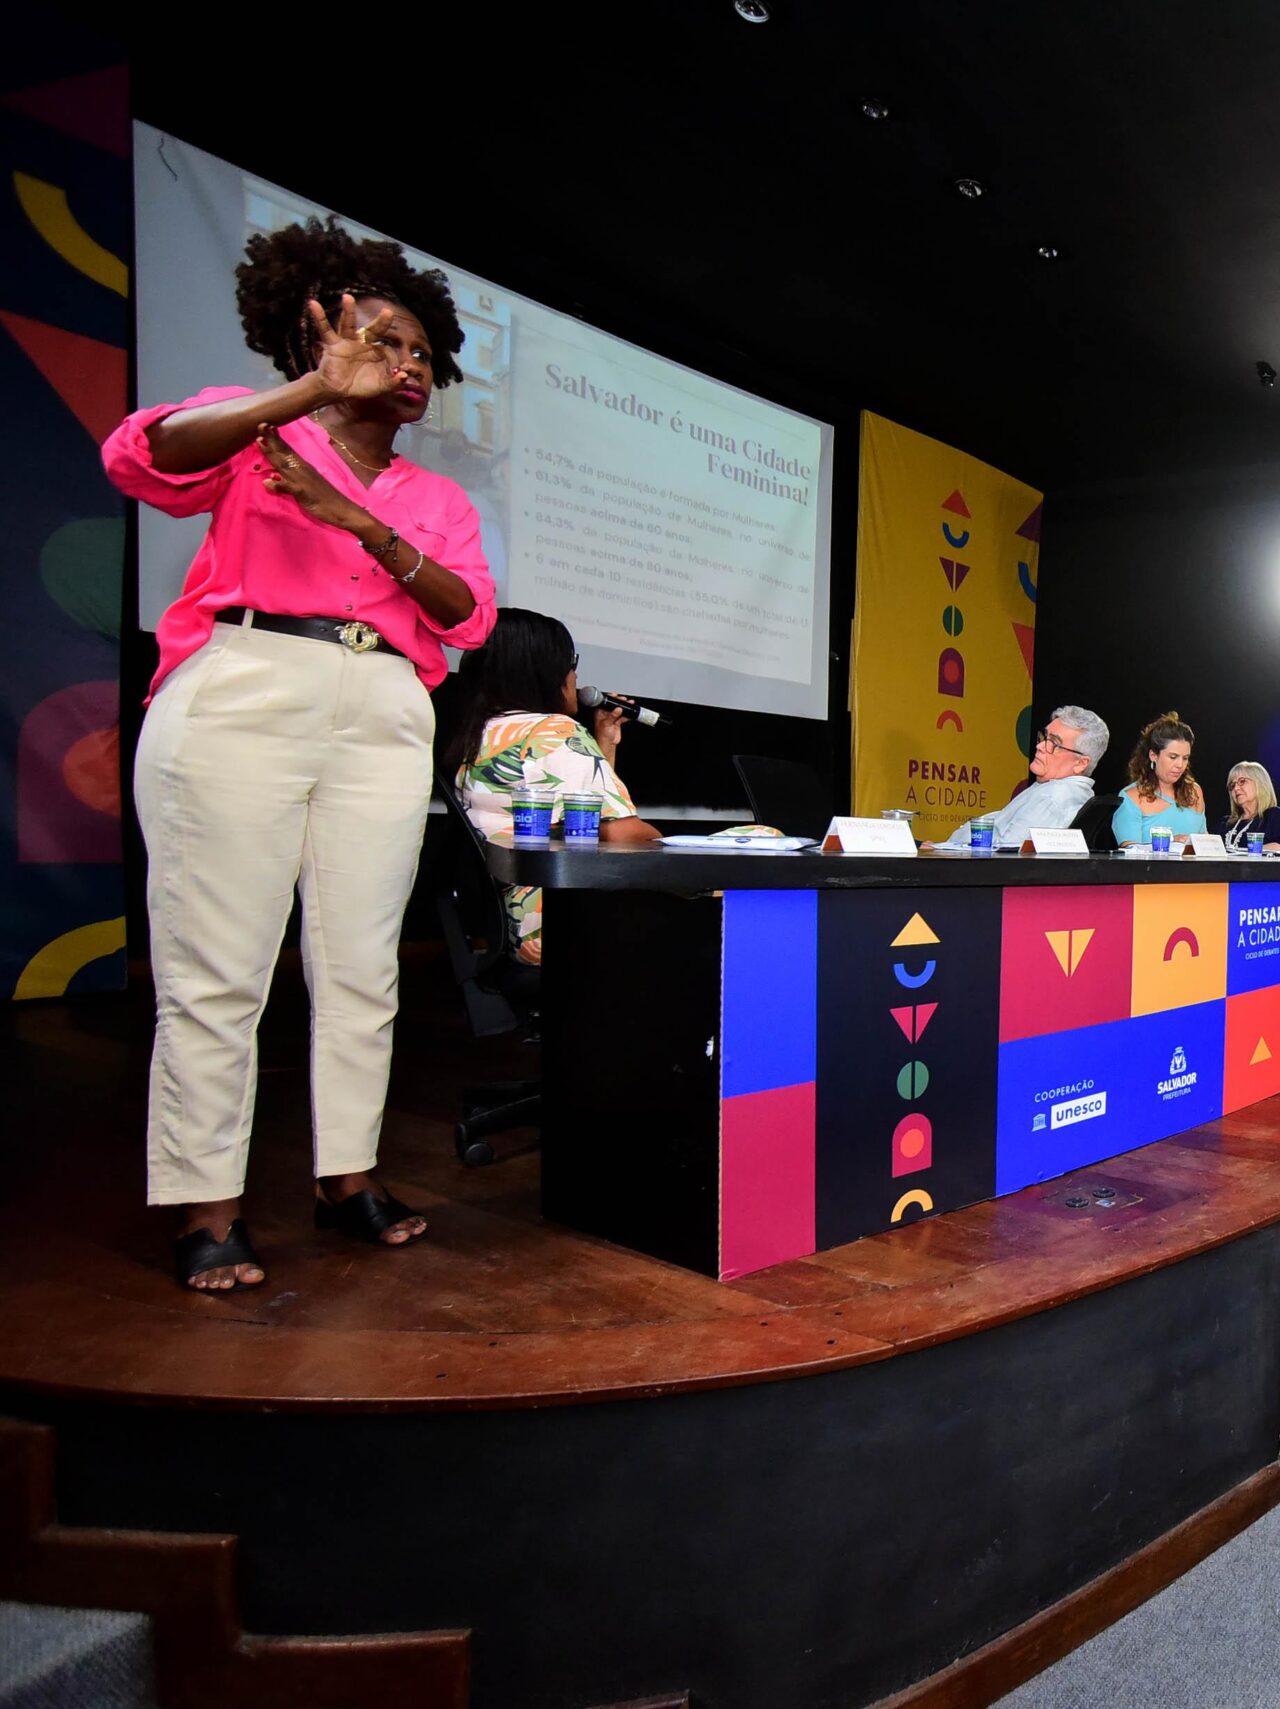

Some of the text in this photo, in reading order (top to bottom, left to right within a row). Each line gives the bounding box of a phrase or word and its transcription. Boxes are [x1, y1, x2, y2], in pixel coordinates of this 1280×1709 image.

[544, 363, 811, 480] Salvador é uma Cidade
[535, 448, 574, 470] 54,7%
[597, 469, 657, 496] população
[669, 490, 710, 513] formada
[535, 469, 572, 490] 61,3%
[602, 491, 661, 516] população
[707, 452, 810, 507] Feminina!
[535, 493, 586, 514] pessoas
[590, 507, 627, 526] acima
[535, 534, 586, 554] pessoas
[590, 549, 626, 564] acima
[536, 552, 544, 565] 6
[549, 558, 570, 571] em
[574, 562, 604, 578] cada
[609, 570, 621, 582] 10
[908, 759, 980, 784] PENSAR
[906, 785, 987, 808] A CIDADE
[1237, 930, 1246, 948] A
[1034, 1079, 1094, 1103] COOPERAÇÃO
[1157, 1072, 1197, 1095] SALVADOR
[1162, 1087, 1192, 1101] PREFEITURA
[1056, 1099, 1102, 1122] unesco
